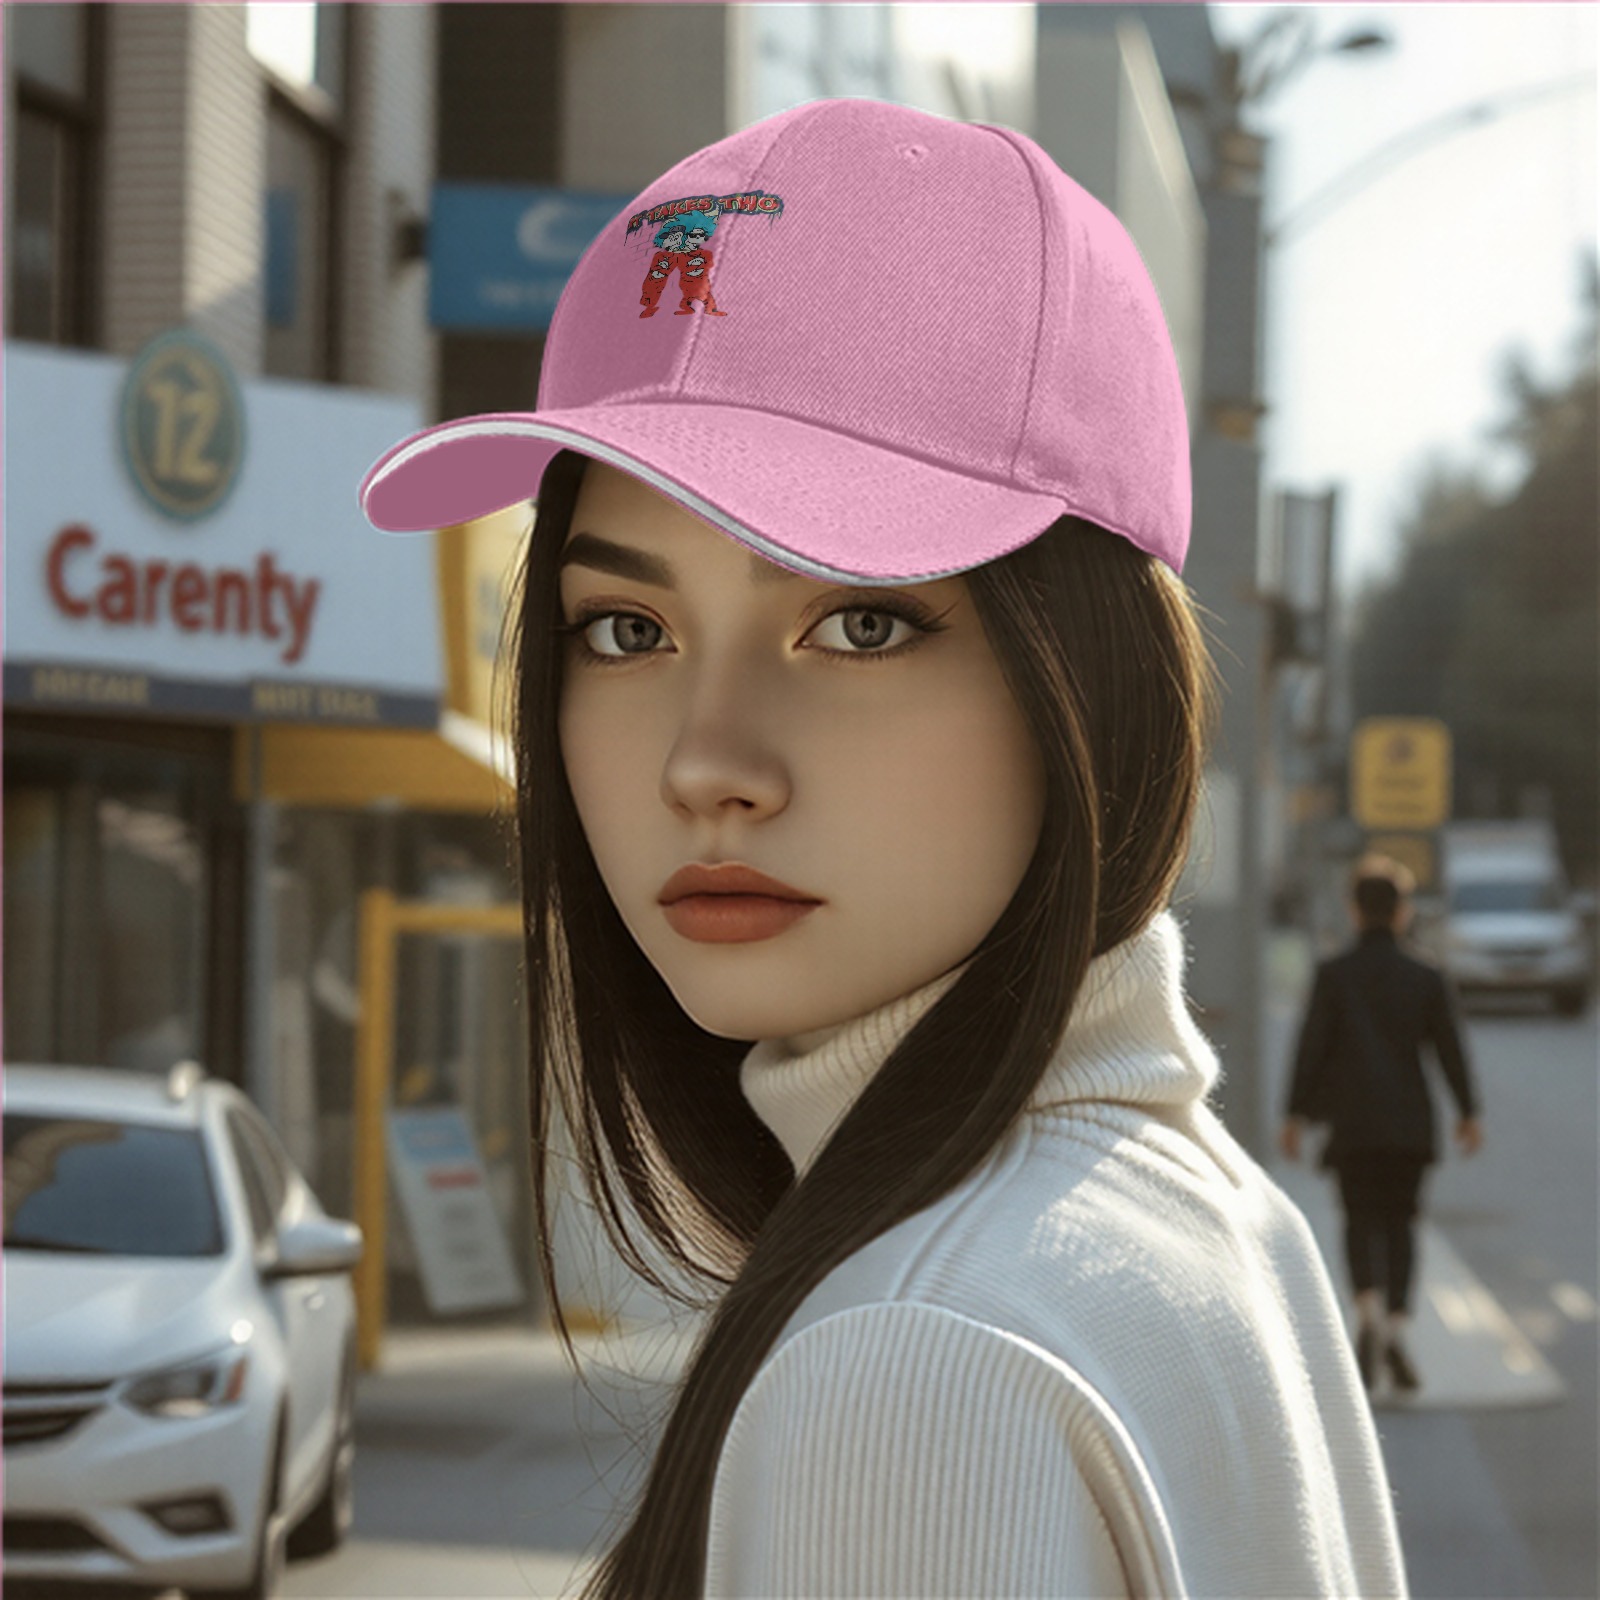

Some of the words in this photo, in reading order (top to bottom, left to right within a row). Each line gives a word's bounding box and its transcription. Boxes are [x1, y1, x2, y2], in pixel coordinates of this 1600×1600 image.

[647, 197, 713, 221] TAKES
[719, 194, 780, 212] TWO
[45, 523, 322, 666] Carenty
